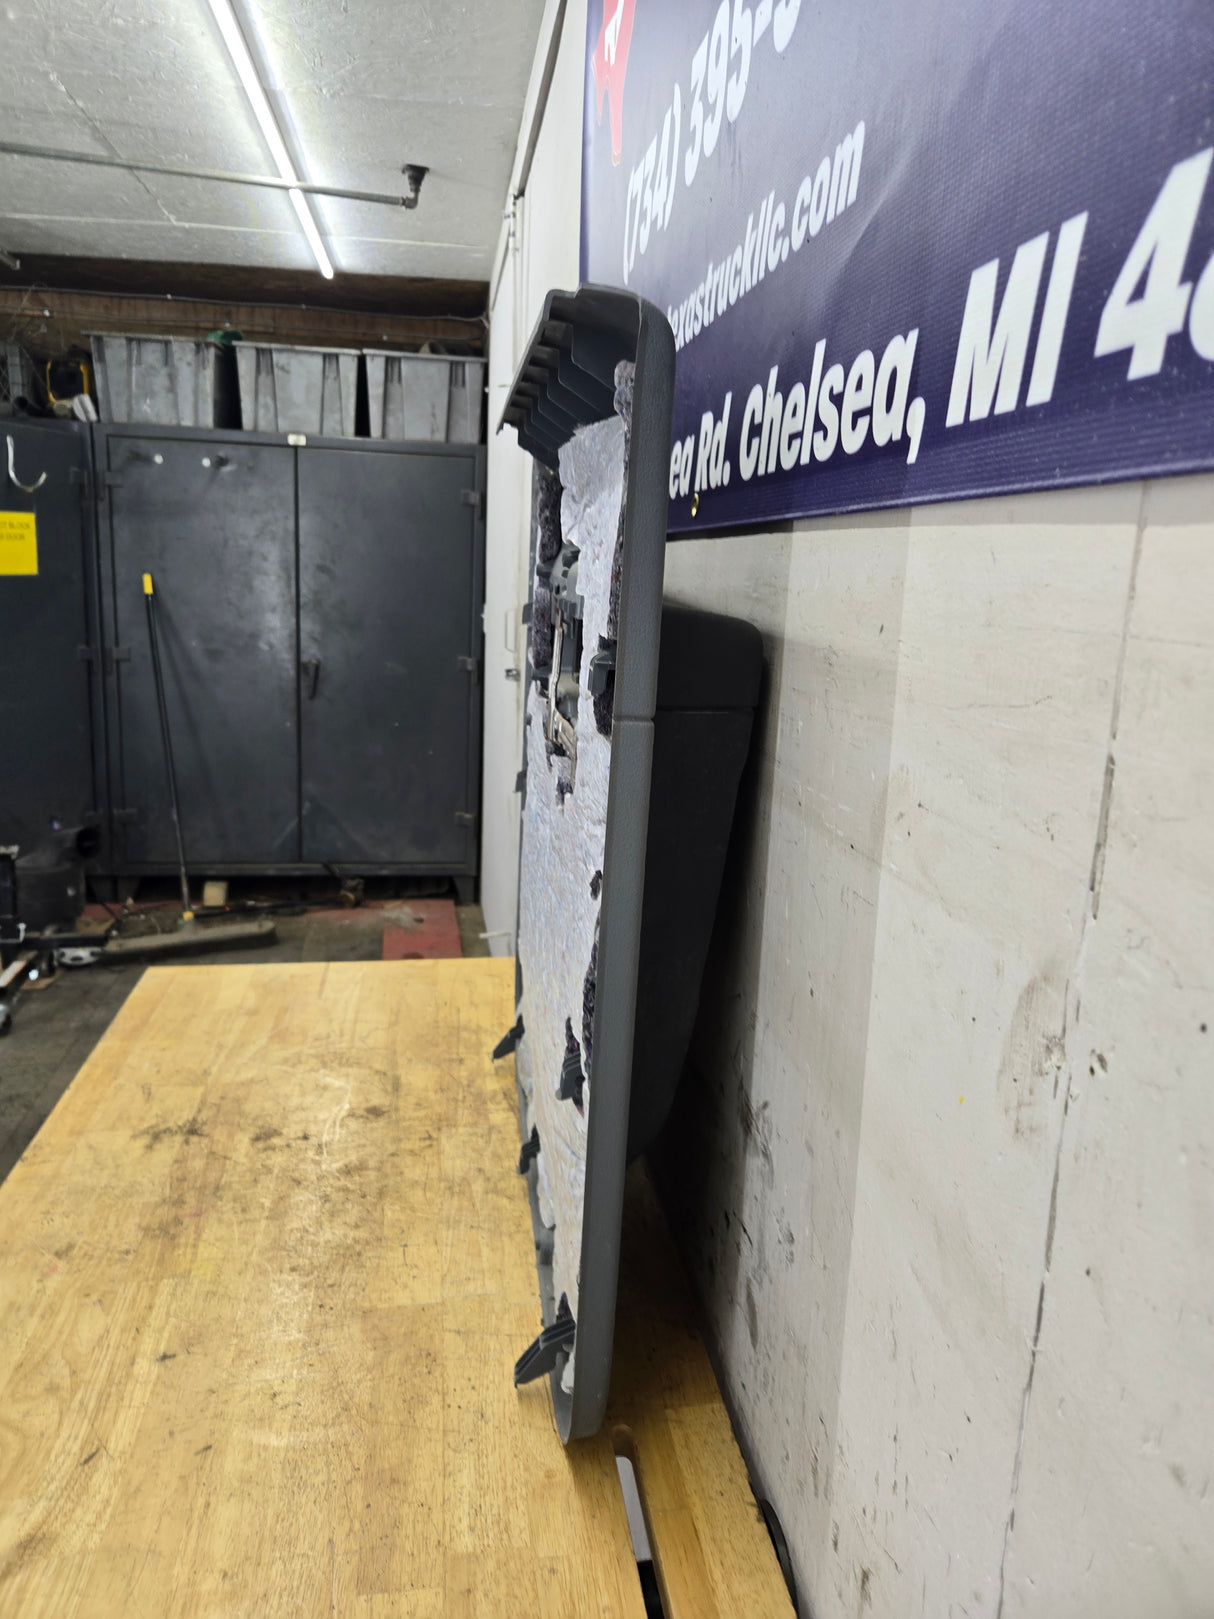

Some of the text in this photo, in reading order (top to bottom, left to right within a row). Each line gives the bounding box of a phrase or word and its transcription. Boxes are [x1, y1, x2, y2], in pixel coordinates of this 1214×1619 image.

[623, 82, 681, 286] (734)
[669, 434, 695, 500] ea
[694, 391, 732, 492] Rd.
[739, 328, 926, 465] Chelsea,
[945, 210, 1089, 428] MI
